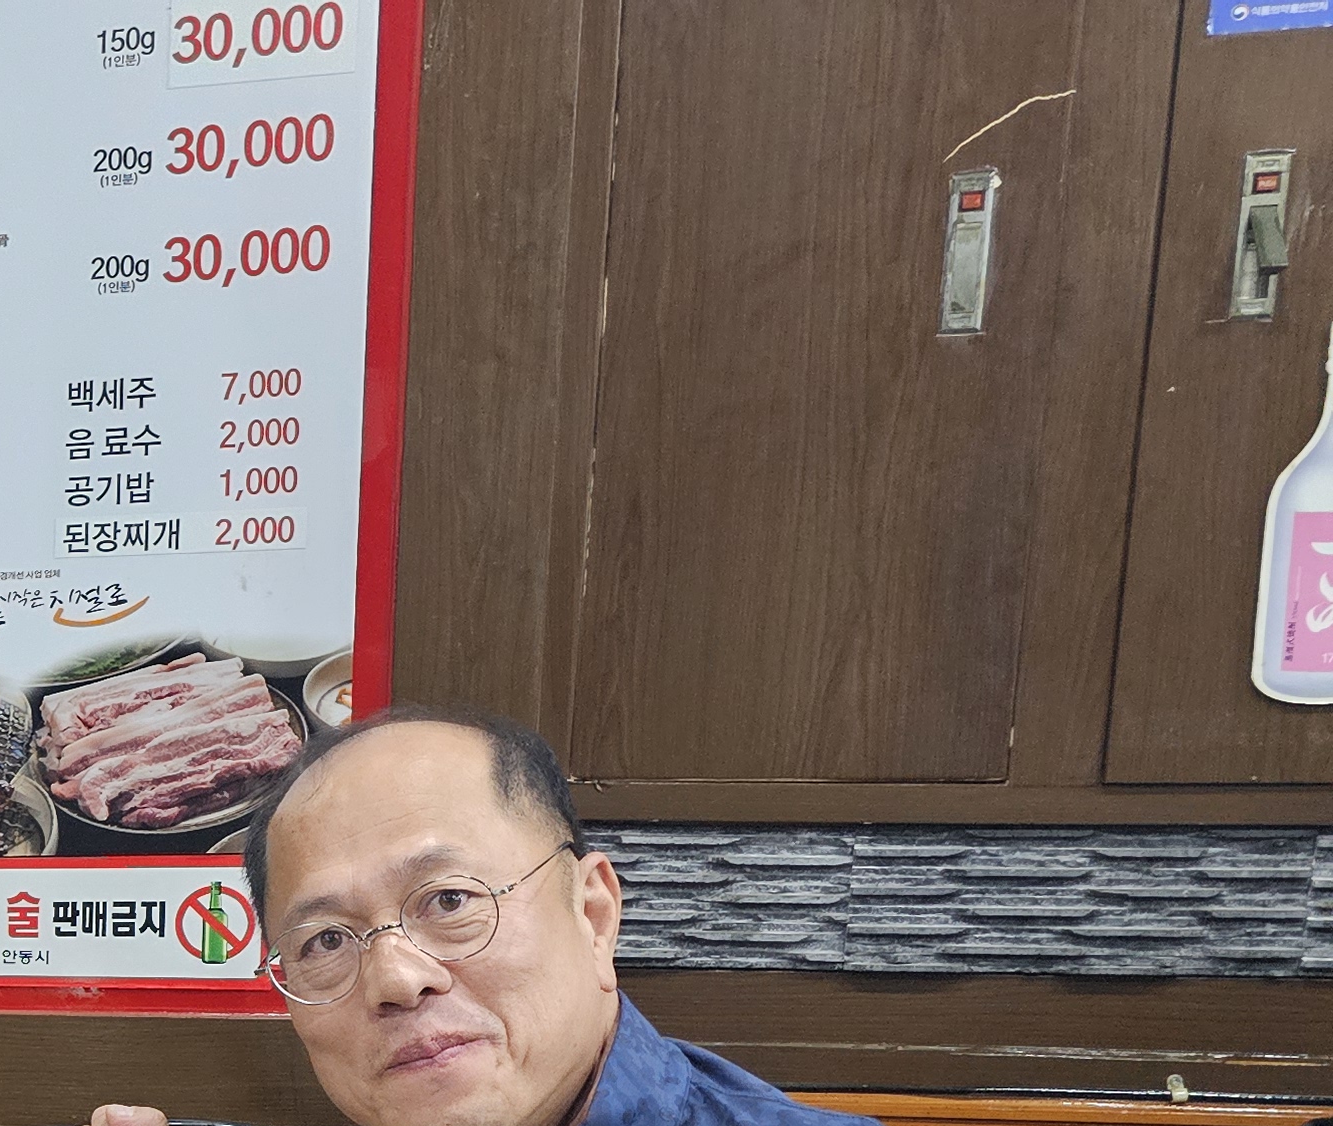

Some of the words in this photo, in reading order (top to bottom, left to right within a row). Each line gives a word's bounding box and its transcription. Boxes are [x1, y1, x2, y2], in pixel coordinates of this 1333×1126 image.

[96, 26, 156, 56] 150g
[171, 1, 343, 69] 30,000
[102, 53, 141, 69] (1인분)
[92, 146, 153, 175] 200g
[165, 113, 334, 179] 30,000
[100, 173, 138, 188] (1인분)
[90, 254, 150, 282] 200g
[162, 224, 331, 288] 30,000
[97, 280, 136, 295] (1인분)
[67, 376, 157, 412] 백세주
[220, 367, 302, 405] 7,000
[219, 416, 300, 454] 2,000
[64, 470, 155, 507] 공기밥
[219, 465, 299, 501] 1,000
[62, 517, 181, 553] 된장찌개
[214, 515, 295, 550] 2,000
[6, 891, 41, 939] 술
[52, 900, 166, 939] 판매금지
[1, 948, 50, 966] 안동시
